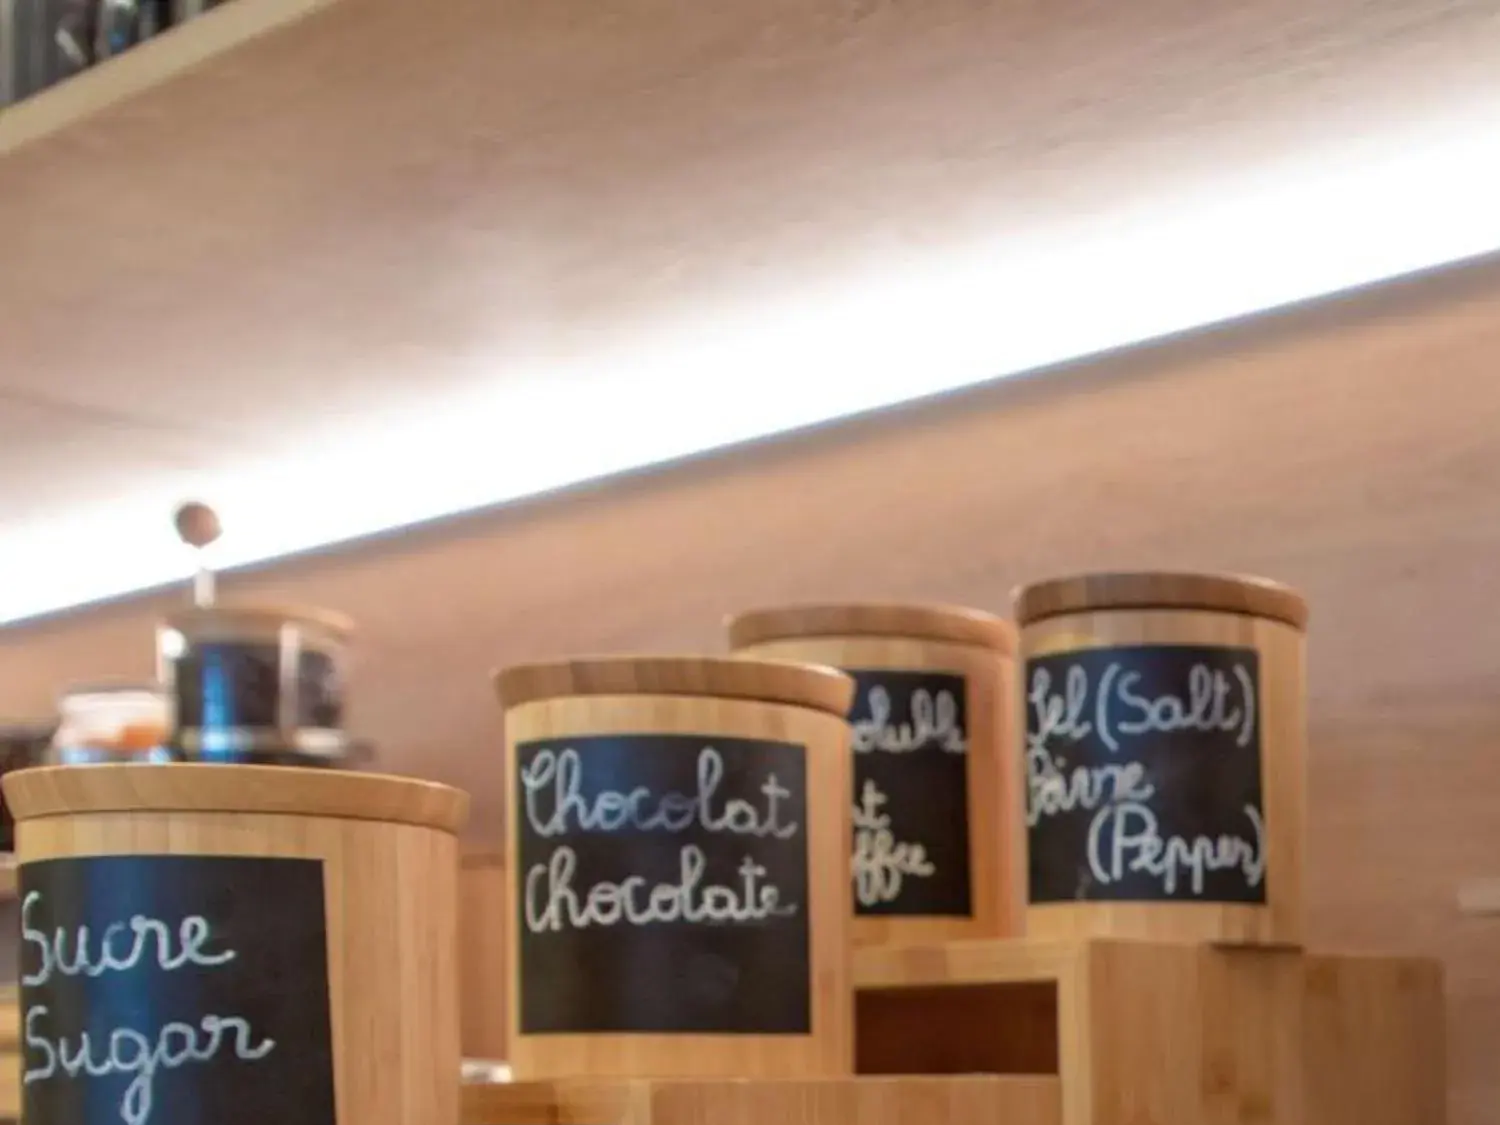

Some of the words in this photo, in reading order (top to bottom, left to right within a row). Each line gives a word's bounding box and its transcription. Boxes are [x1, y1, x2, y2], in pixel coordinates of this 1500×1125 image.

[1094, 663, 1254, 751] (Salt)
[521, 746, 797, 838] Chocolat
[525, 844, 798, 933] Chocolate
[1087, 803, 1268, 894] (Pepper)
[22, 890, 237, 987] Sucre
